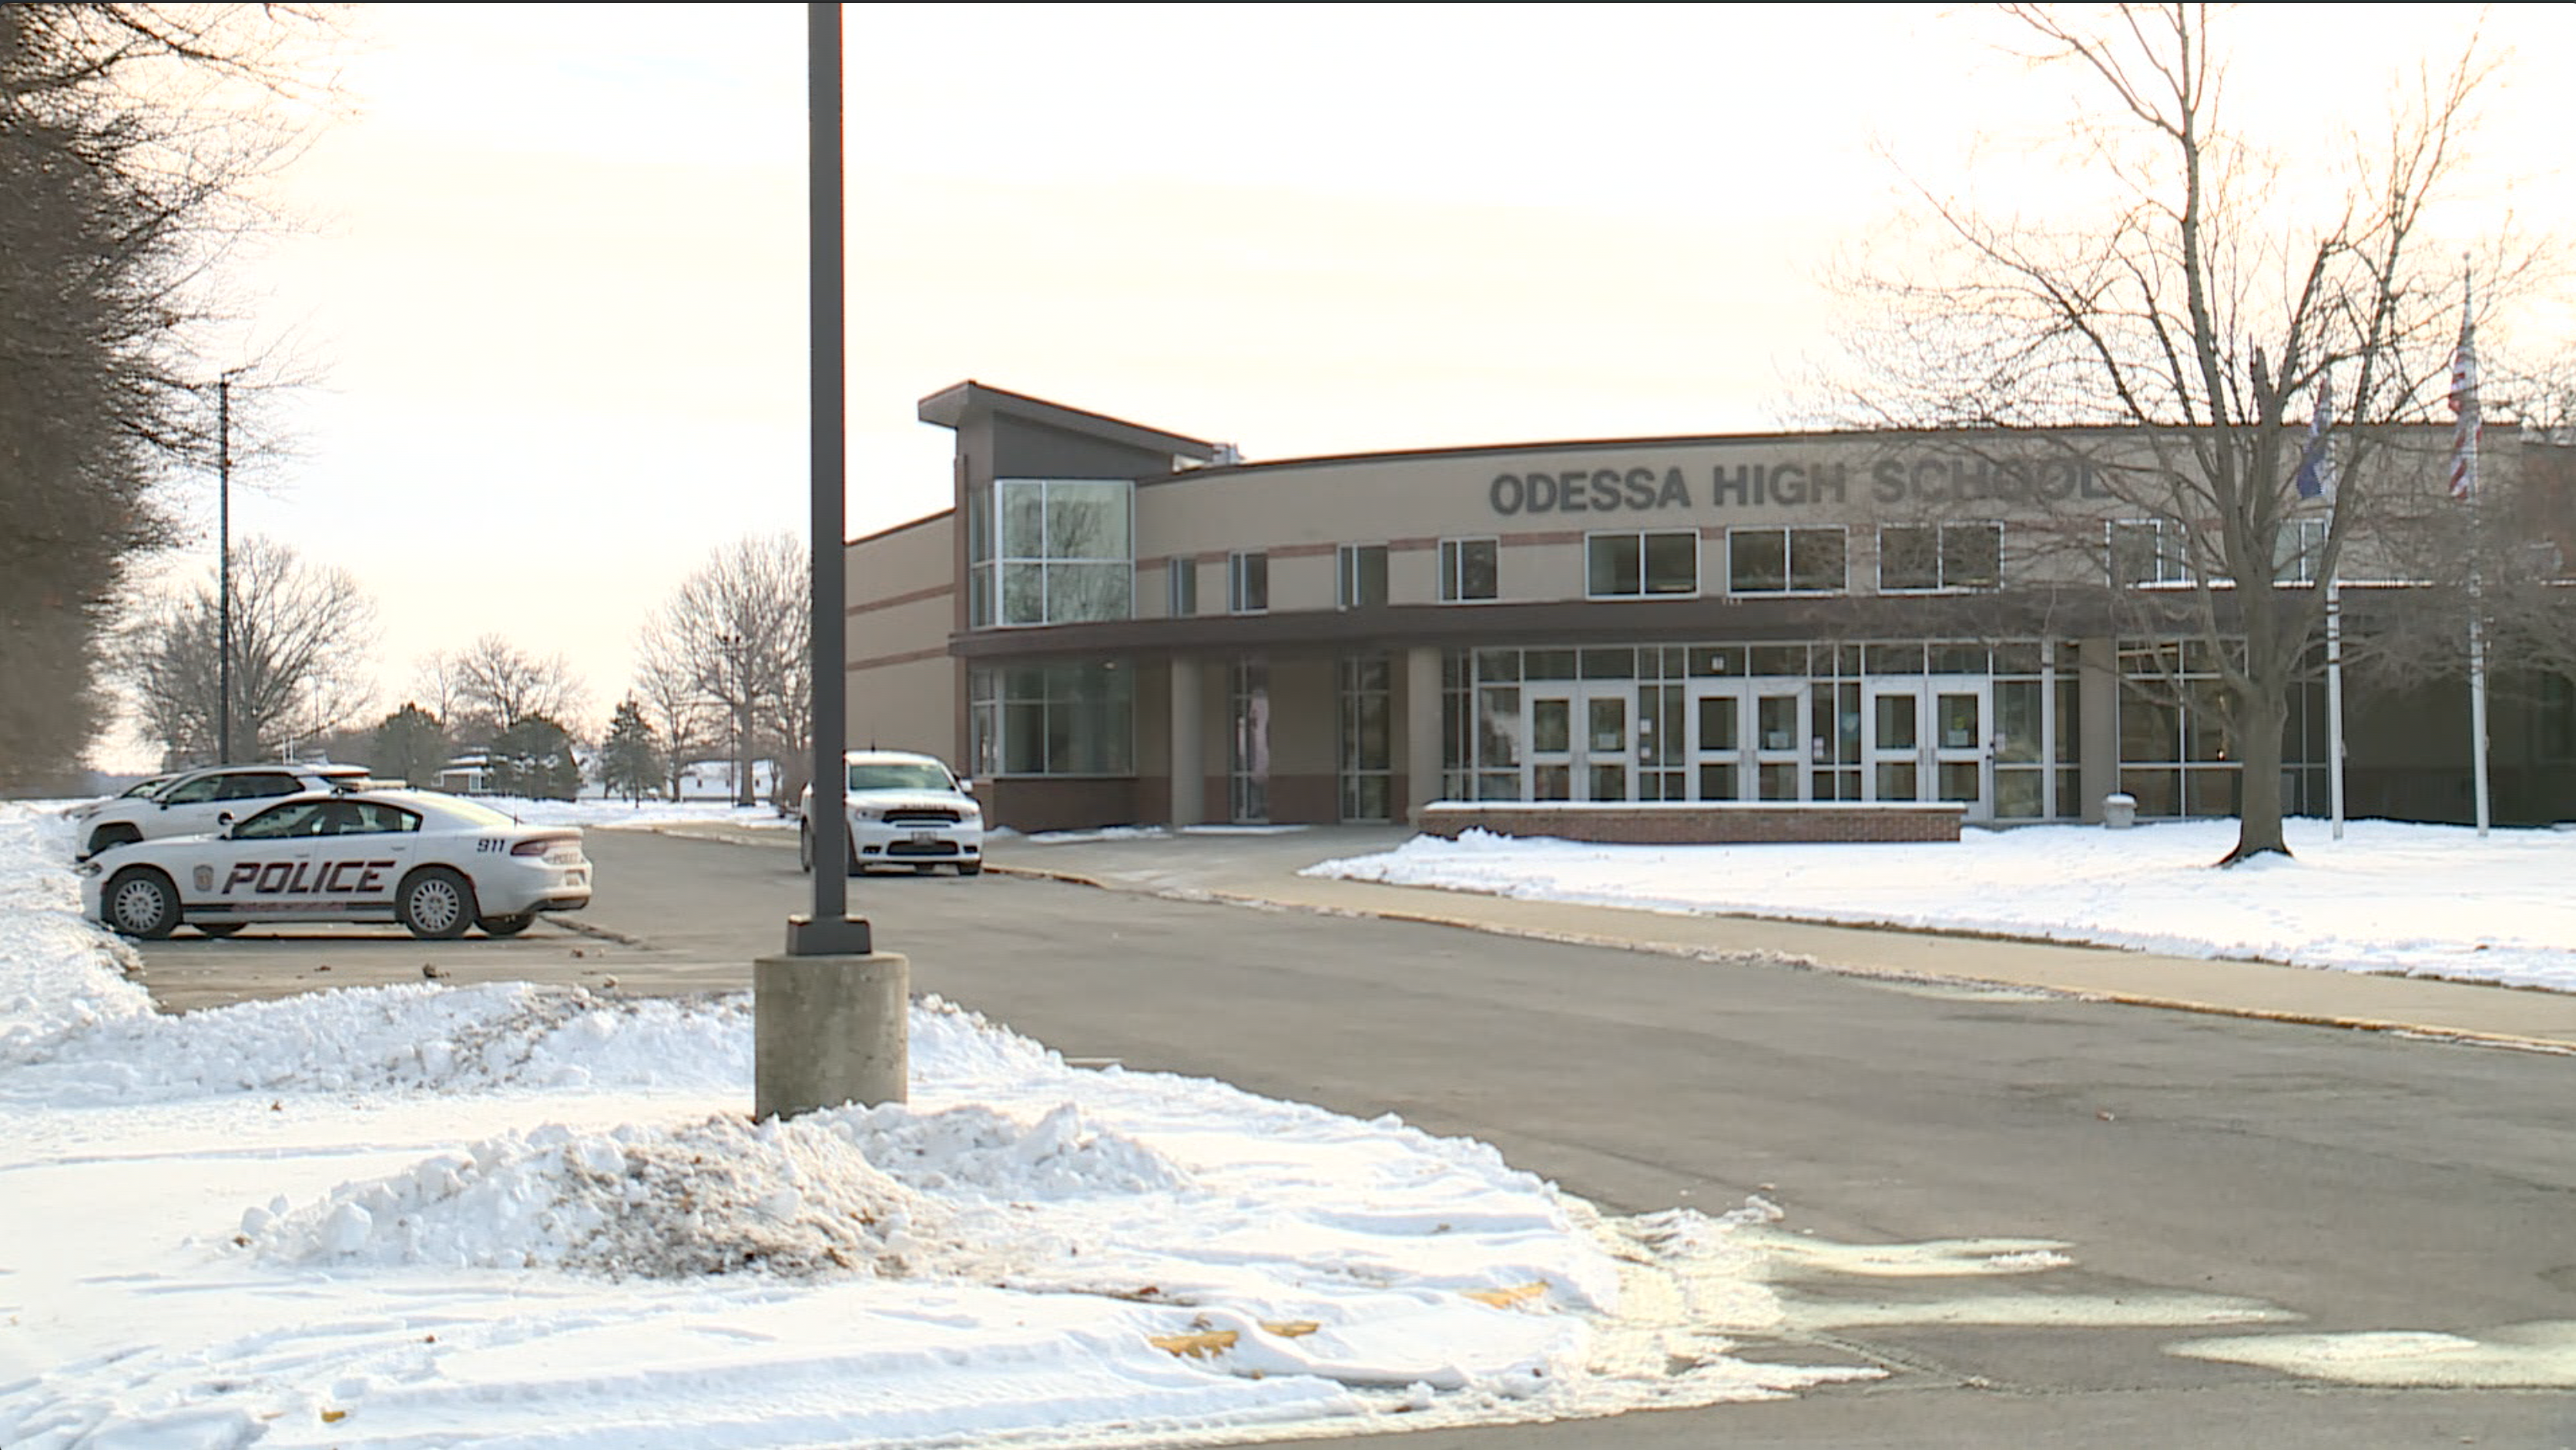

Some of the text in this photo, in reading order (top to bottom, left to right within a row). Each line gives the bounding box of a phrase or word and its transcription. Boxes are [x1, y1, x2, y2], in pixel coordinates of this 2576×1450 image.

[1490, 460, 2112, 515] ODESSA HIGH SCHOOL
[478, 838, 505, 852] 911
[222, 861, 396, 894] POLICE
